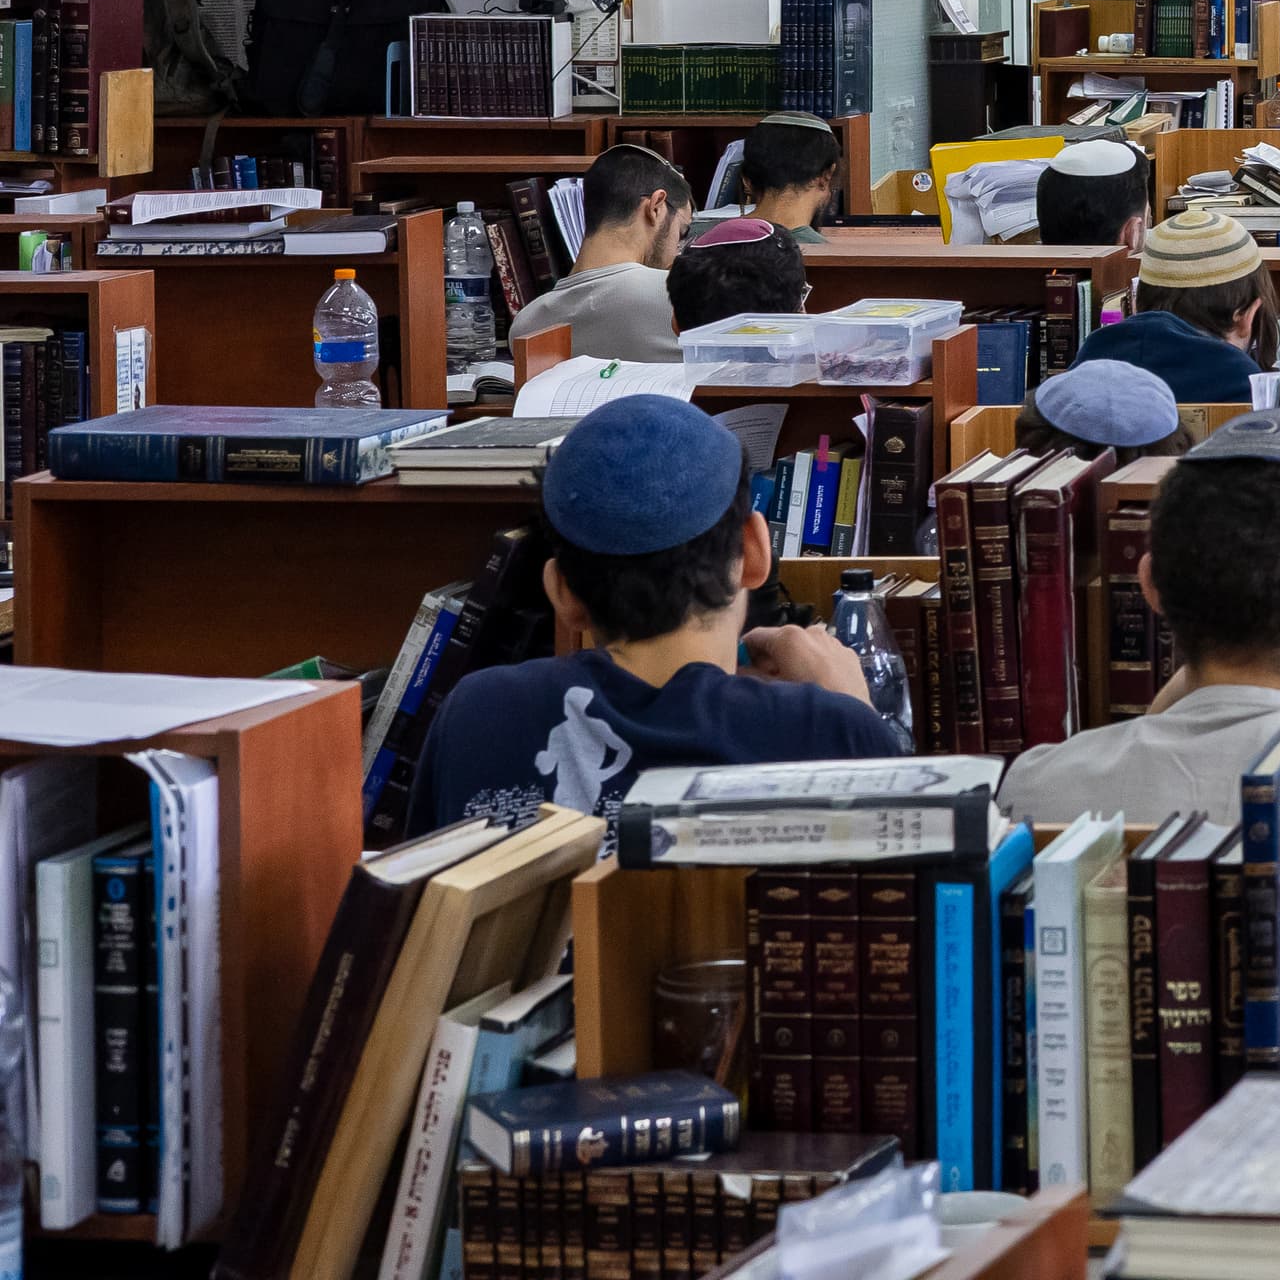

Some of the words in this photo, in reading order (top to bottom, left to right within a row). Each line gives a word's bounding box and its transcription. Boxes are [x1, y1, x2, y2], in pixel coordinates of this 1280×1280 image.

[1132, 914, 1152, 961] ספר
[1133, 967, 1153, 1041] הכוזרי
[1166, 981, 1200, 1001] ספר
[1158, 1007, 1211, 1030] החינוך
